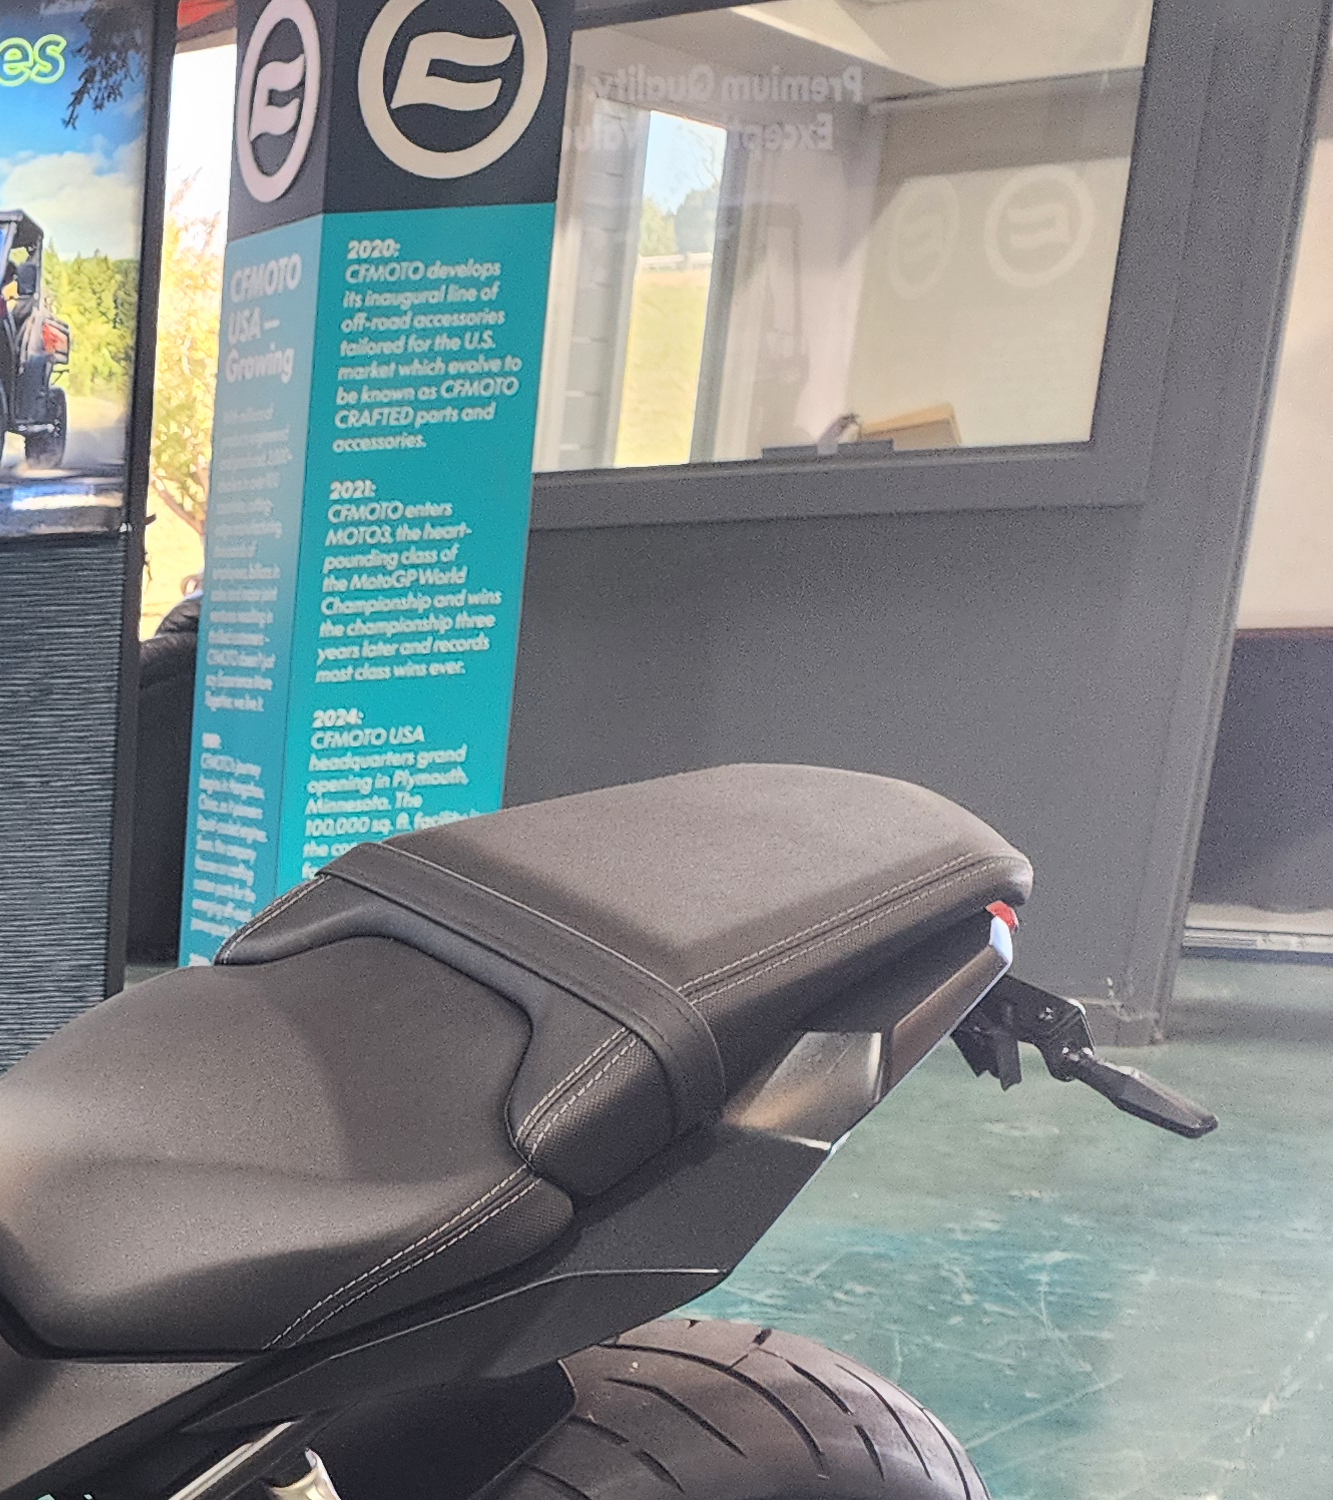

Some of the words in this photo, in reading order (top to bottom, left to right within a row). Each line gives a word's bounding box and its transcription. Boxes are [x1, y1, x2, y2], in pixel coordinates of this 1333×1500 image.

[230, 253, 302, 303] CFMOTO
[228, 306, 262, 345] USA
[225, 342, 295, 384] Growing
[311, 727, 386, 749] CFMOTO
[389, 724, 425, 744] USA
[312, 707, 363, 728] 2024:
